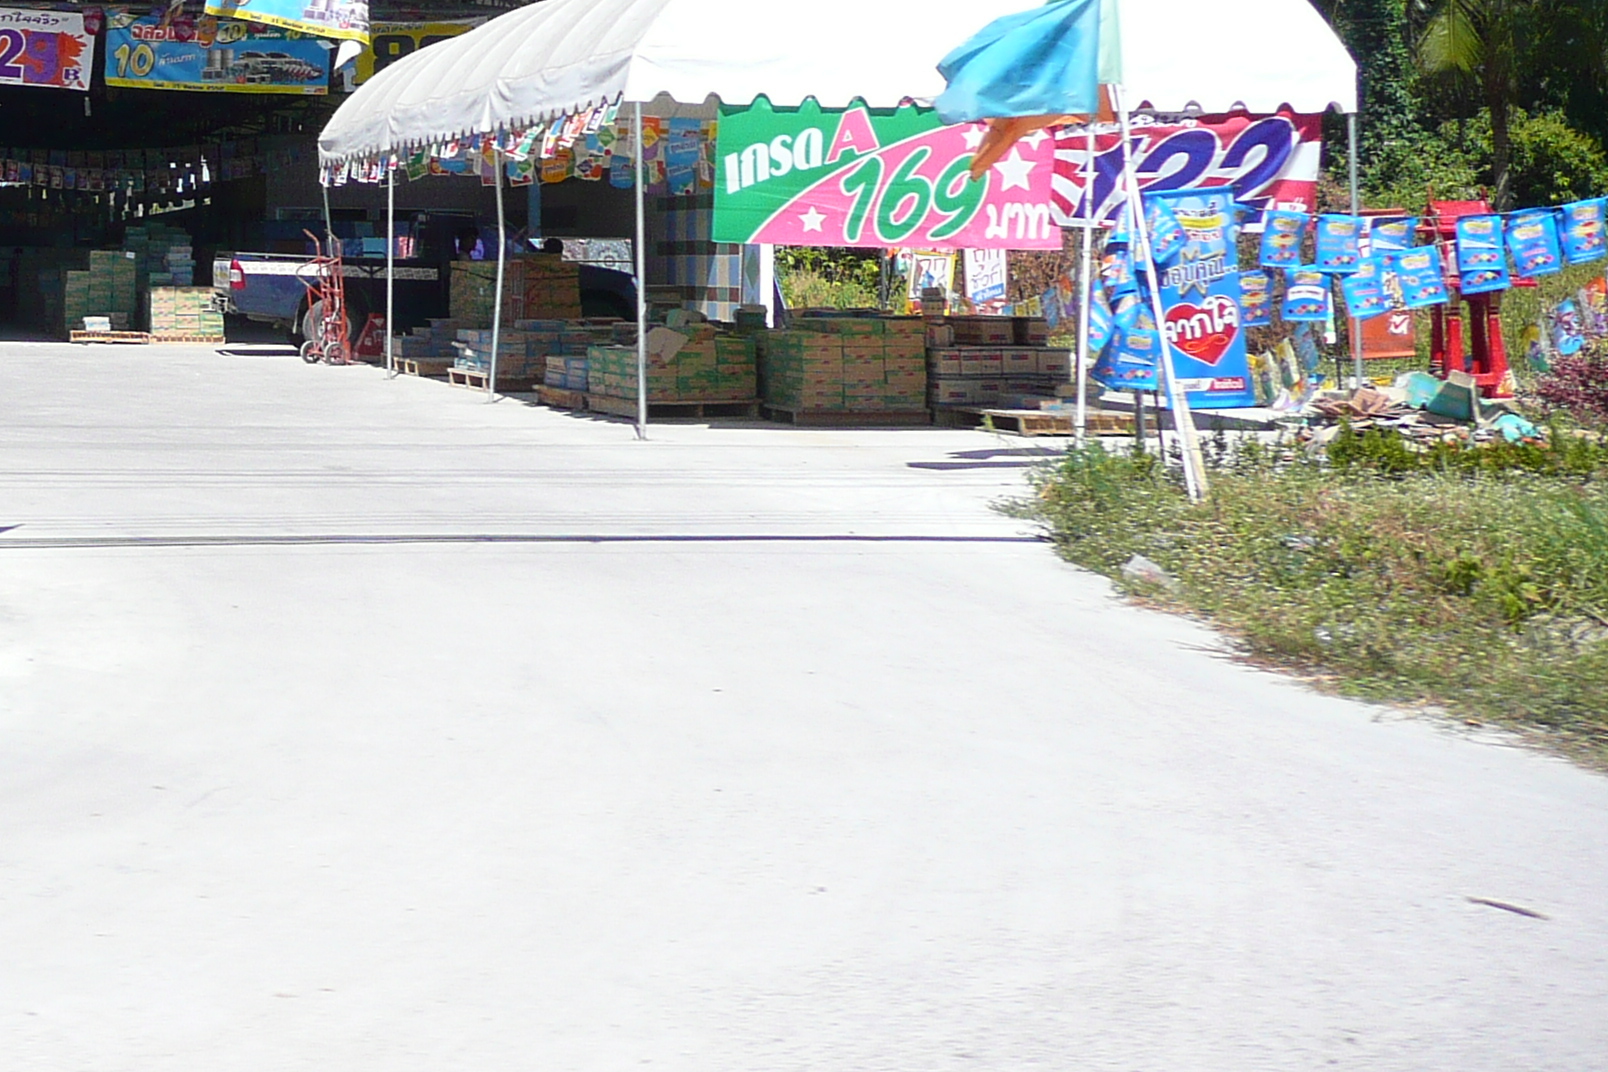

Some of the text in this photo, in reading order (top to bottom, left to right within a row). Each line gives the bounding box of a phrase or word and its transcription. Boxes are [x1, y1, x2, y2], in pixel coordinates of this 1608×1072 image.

[114, 44, 155, 77] 10
[724, 106, 880, 194] เกรด A
[842, 145, 990, 243] 169
[985, 203, 1051, 239] บาท
[1165, 297, 1239, 343] จากใจ
